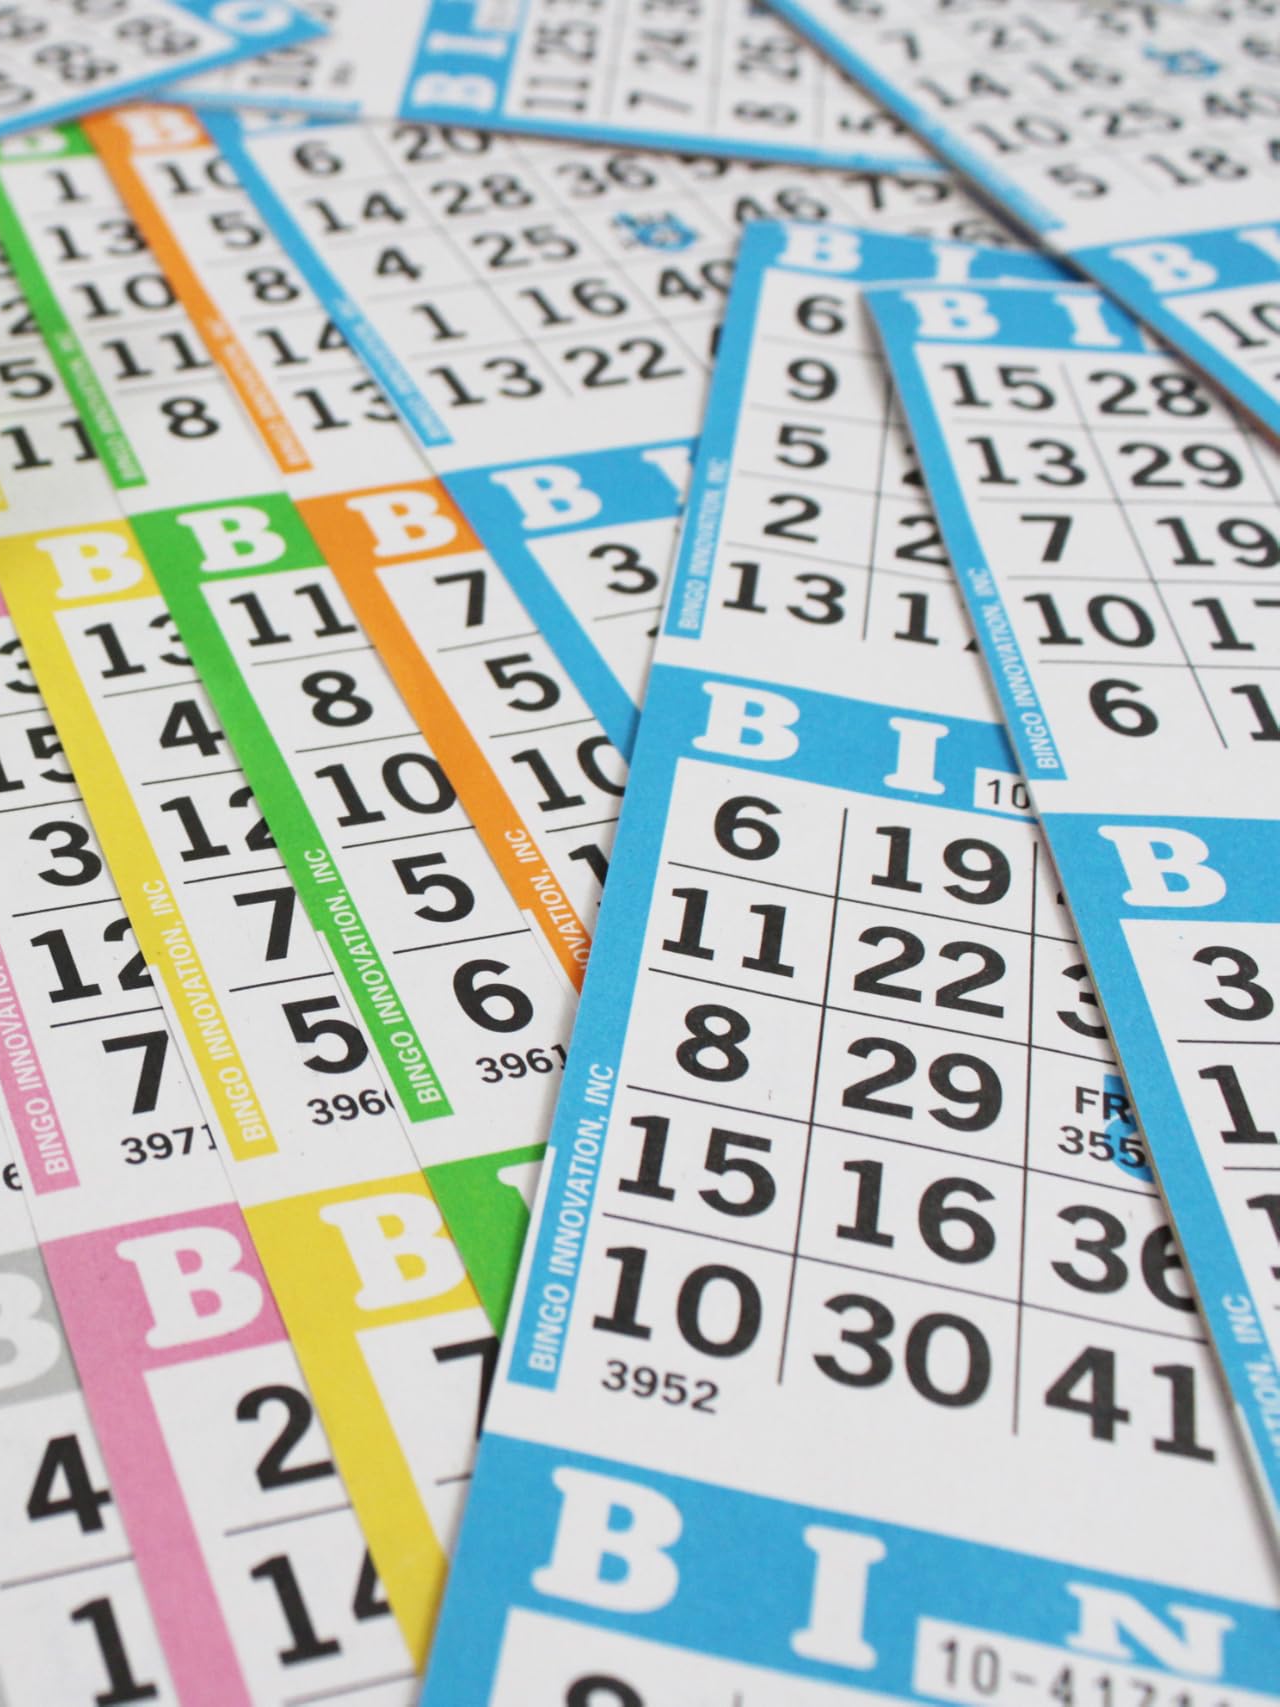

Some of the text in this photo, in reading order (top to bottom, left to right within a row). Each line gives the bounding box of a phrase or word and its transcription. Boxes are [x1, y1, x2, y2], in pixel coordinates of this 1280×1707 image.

[429, 174, 534, 216] 28
[470, 227, 580, 271] 25
[795, 294, 846, 336] 6
[428, 337, 685, 407] 13 22
[786, 358, 838, 402] 9
[942, 362, 1210, 417] 15 28
[159, 396, 220, 440] 8
[775, 424, 830, 470] 5
[967, 436, 1244, 490] 13 29
[346, 490, 458, 558] B
[490, 464, 603, 531] B
[762, 494, 822, 544] 2
[35, 532, 145, 600] B
[177, 506, 286, 573] B
[1020, 515, 1280, 570] 7 19
[229, 582, 356, 648] 11
[435, 569, 487, 628] 7
[677, 579, 707, 630] BINGO
[722, 561, 847, 626] 13
[968, 567, 995, 596] INC
[1022, 594, 1155, 648] 10
[301, 670, 374, 728] 8
[484, 653, 562, 712] 5
[1087, 678, 1159, 738] 6
[692, 681, 801, 761] B
[1021, 711, 1059, 769] BINGO
[315, 752, 457, 827] 10
[27, 820, 103, 886] 3
[504, 829, 540, 864] INC
[712, 795, 1011, 905] 6 19
[1098, 825, 1226, 908] B
[392, 852, 475, 923] 5
[233, 886, 298, 963] 7
[661, 886, 1007, 1019] 11 22
[304, 848, 442, 1104] BINGO INNOVATION, INC
[452, 958, 534, 1034] 6
[143, 879, 268, 1142] BINGO INNOVATION, INC
[282, 995, 369, 1075] 5
[102, 1030, 169, 1115] 7
[475, 1043, 567, 1084] 3961
[675, 1004, 1003, 1133] 8 29
[25, 1097, 70, 1176] BINGO
[120, 1124, 217, 1165] 3971
[528, 1063, 615, 1372] BINGO INNOVATION, INC
[616, 1114, 997, 1265] 15 16
[318, 1192, 466, 1311] B
[115, 1225, 264, 1350] B
[591, 1243, 763, 1360] 10
[812, 1292, 992, 1409] 30
[1043, 1345, 1217, 1465] 41
[600, 1358, 721, 1414] 3952
[235, 1384, 335, 1493] 2
[26, 1433, 113, 1536] 4
[530, 1465, 684, 1616] B
